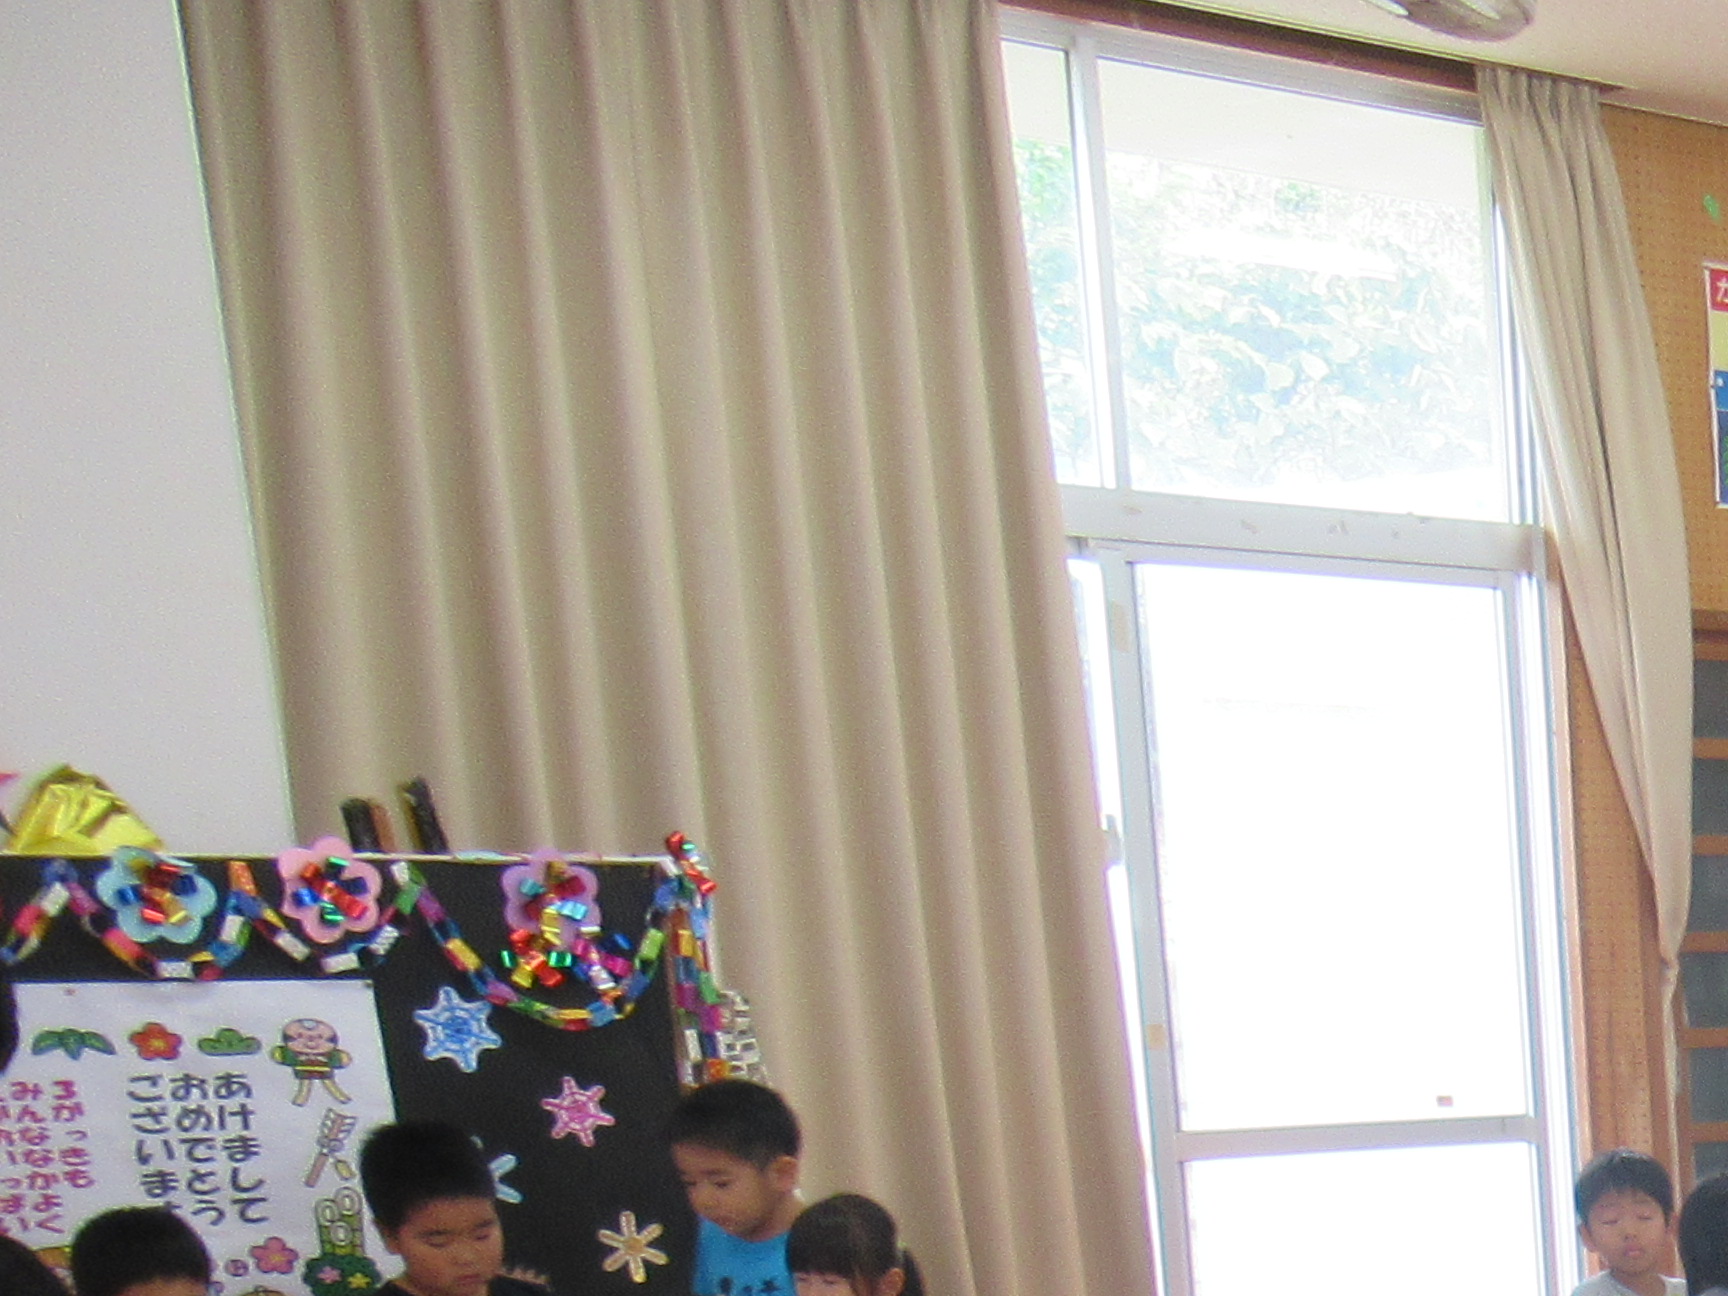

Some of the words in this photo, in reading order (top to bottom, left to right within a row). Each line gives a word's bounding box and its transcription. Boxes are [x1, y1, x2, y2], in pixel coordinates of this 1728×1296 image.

[169, 1073, 226, 1226] おめでとう
[214, 1072, 269, 1223] あけまして
